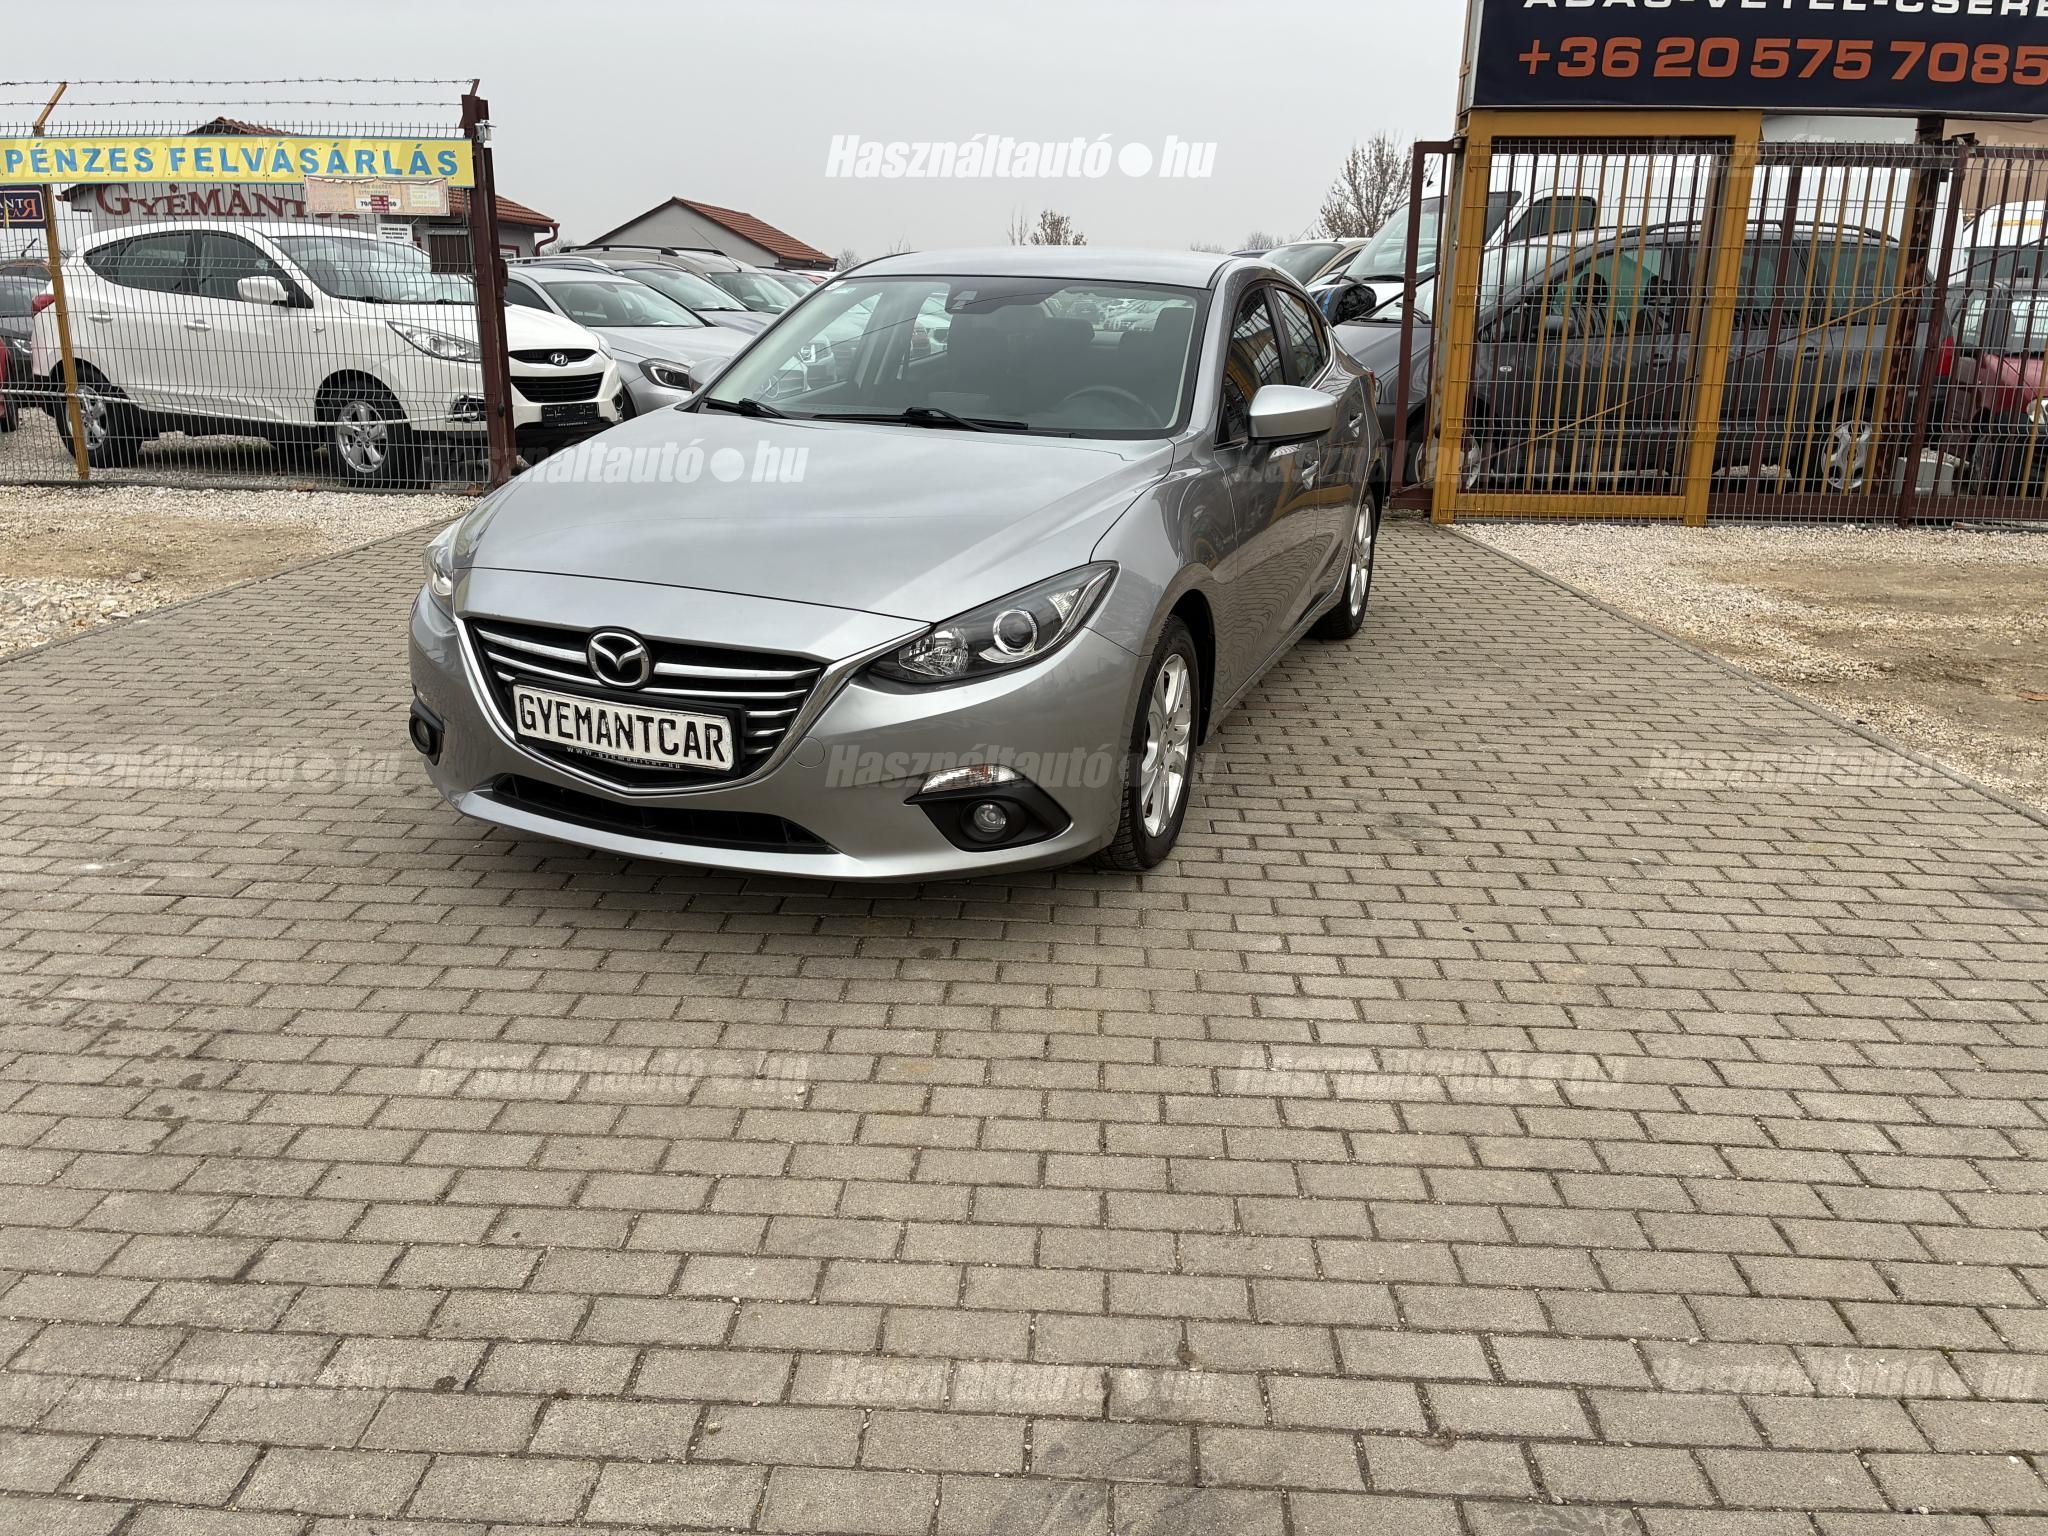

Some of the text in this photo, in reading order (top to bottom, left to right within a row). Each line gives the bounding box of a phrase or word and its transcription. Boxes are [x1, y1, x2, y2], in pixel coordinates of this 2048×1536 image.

[1519, 37, 2048, 86] +36 20 575 7085
[5, 142, 458, 177] PÉNZES FELVÁSÁRLÁS
[518, 693, 725, 762] GYEMANTCAR
